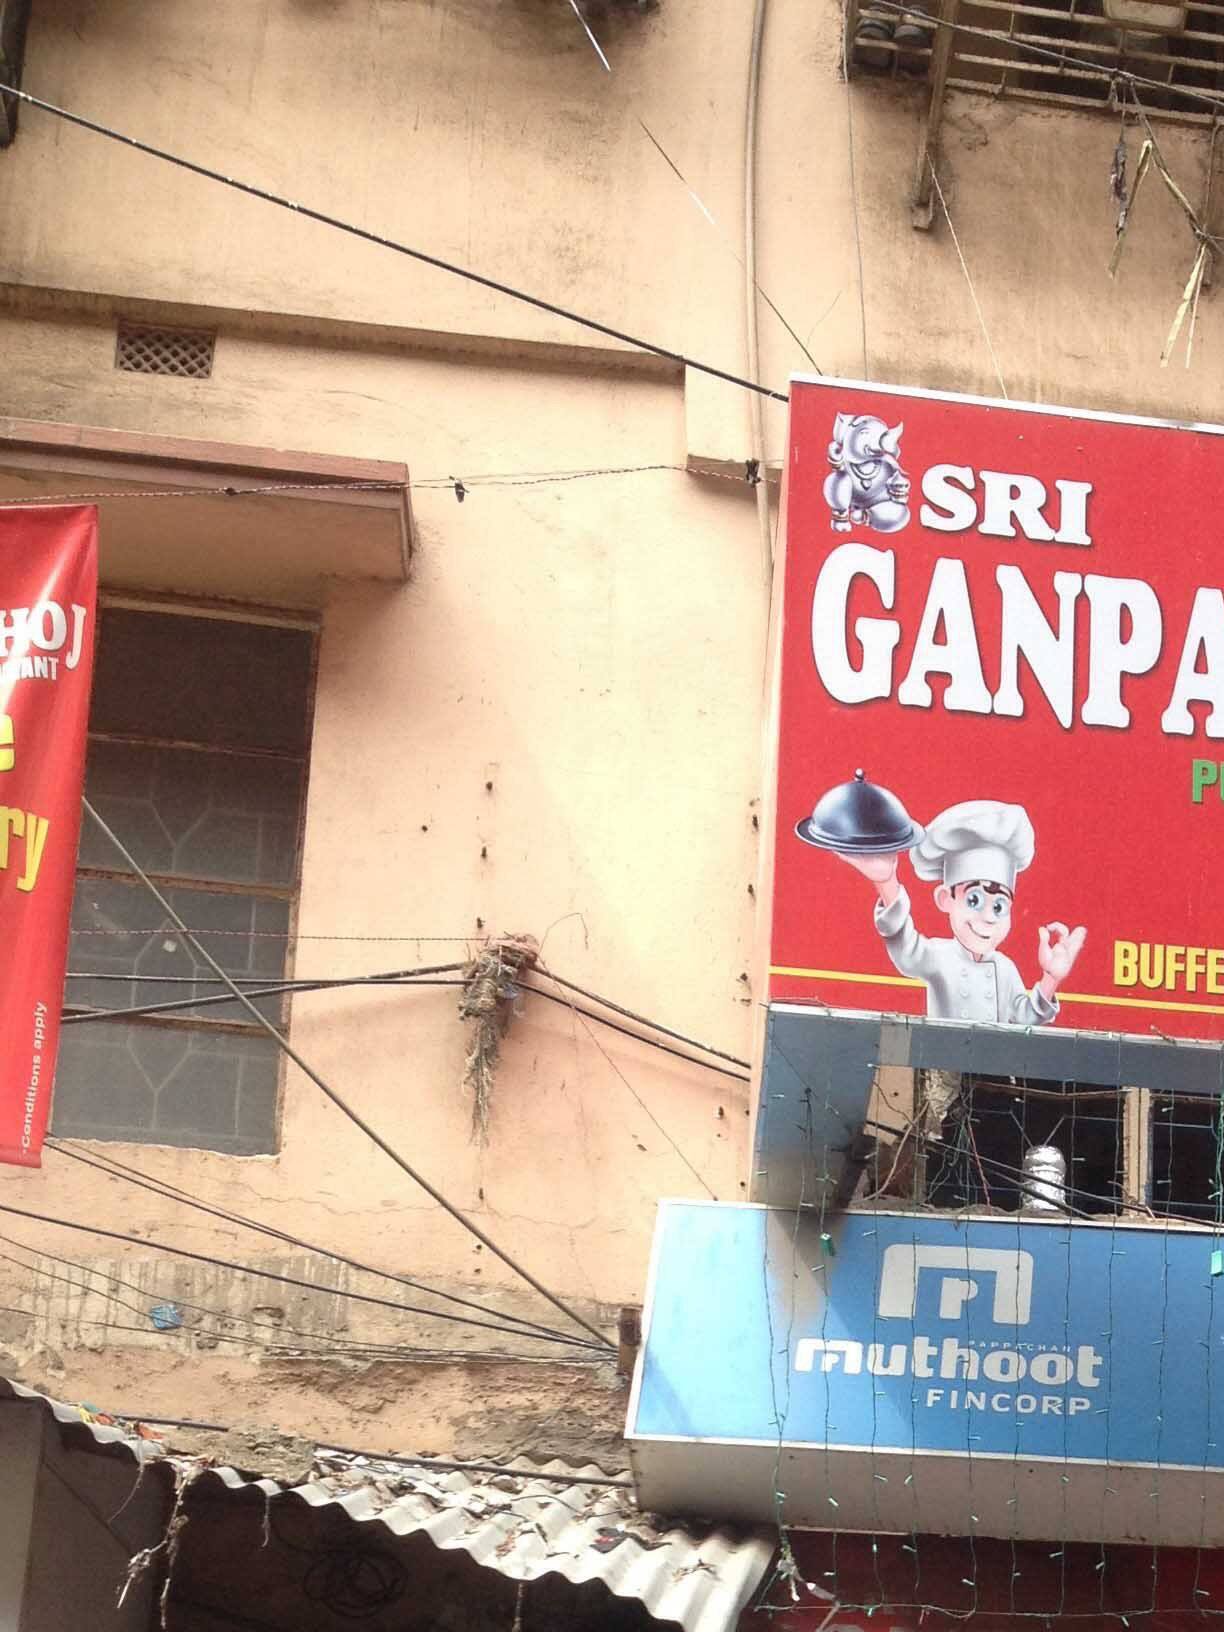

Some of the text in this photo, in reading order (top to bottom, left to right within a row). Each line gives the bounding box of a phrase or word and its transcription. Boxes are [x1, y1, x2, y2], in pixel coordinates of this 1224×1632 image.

[918, 462, 1093, 546] SRI
[33, 1001, 48, 1050] apply
[793, 1335, 1104, 1388] muthoot
[925, 1388, 1092, 1416] FINCORP
